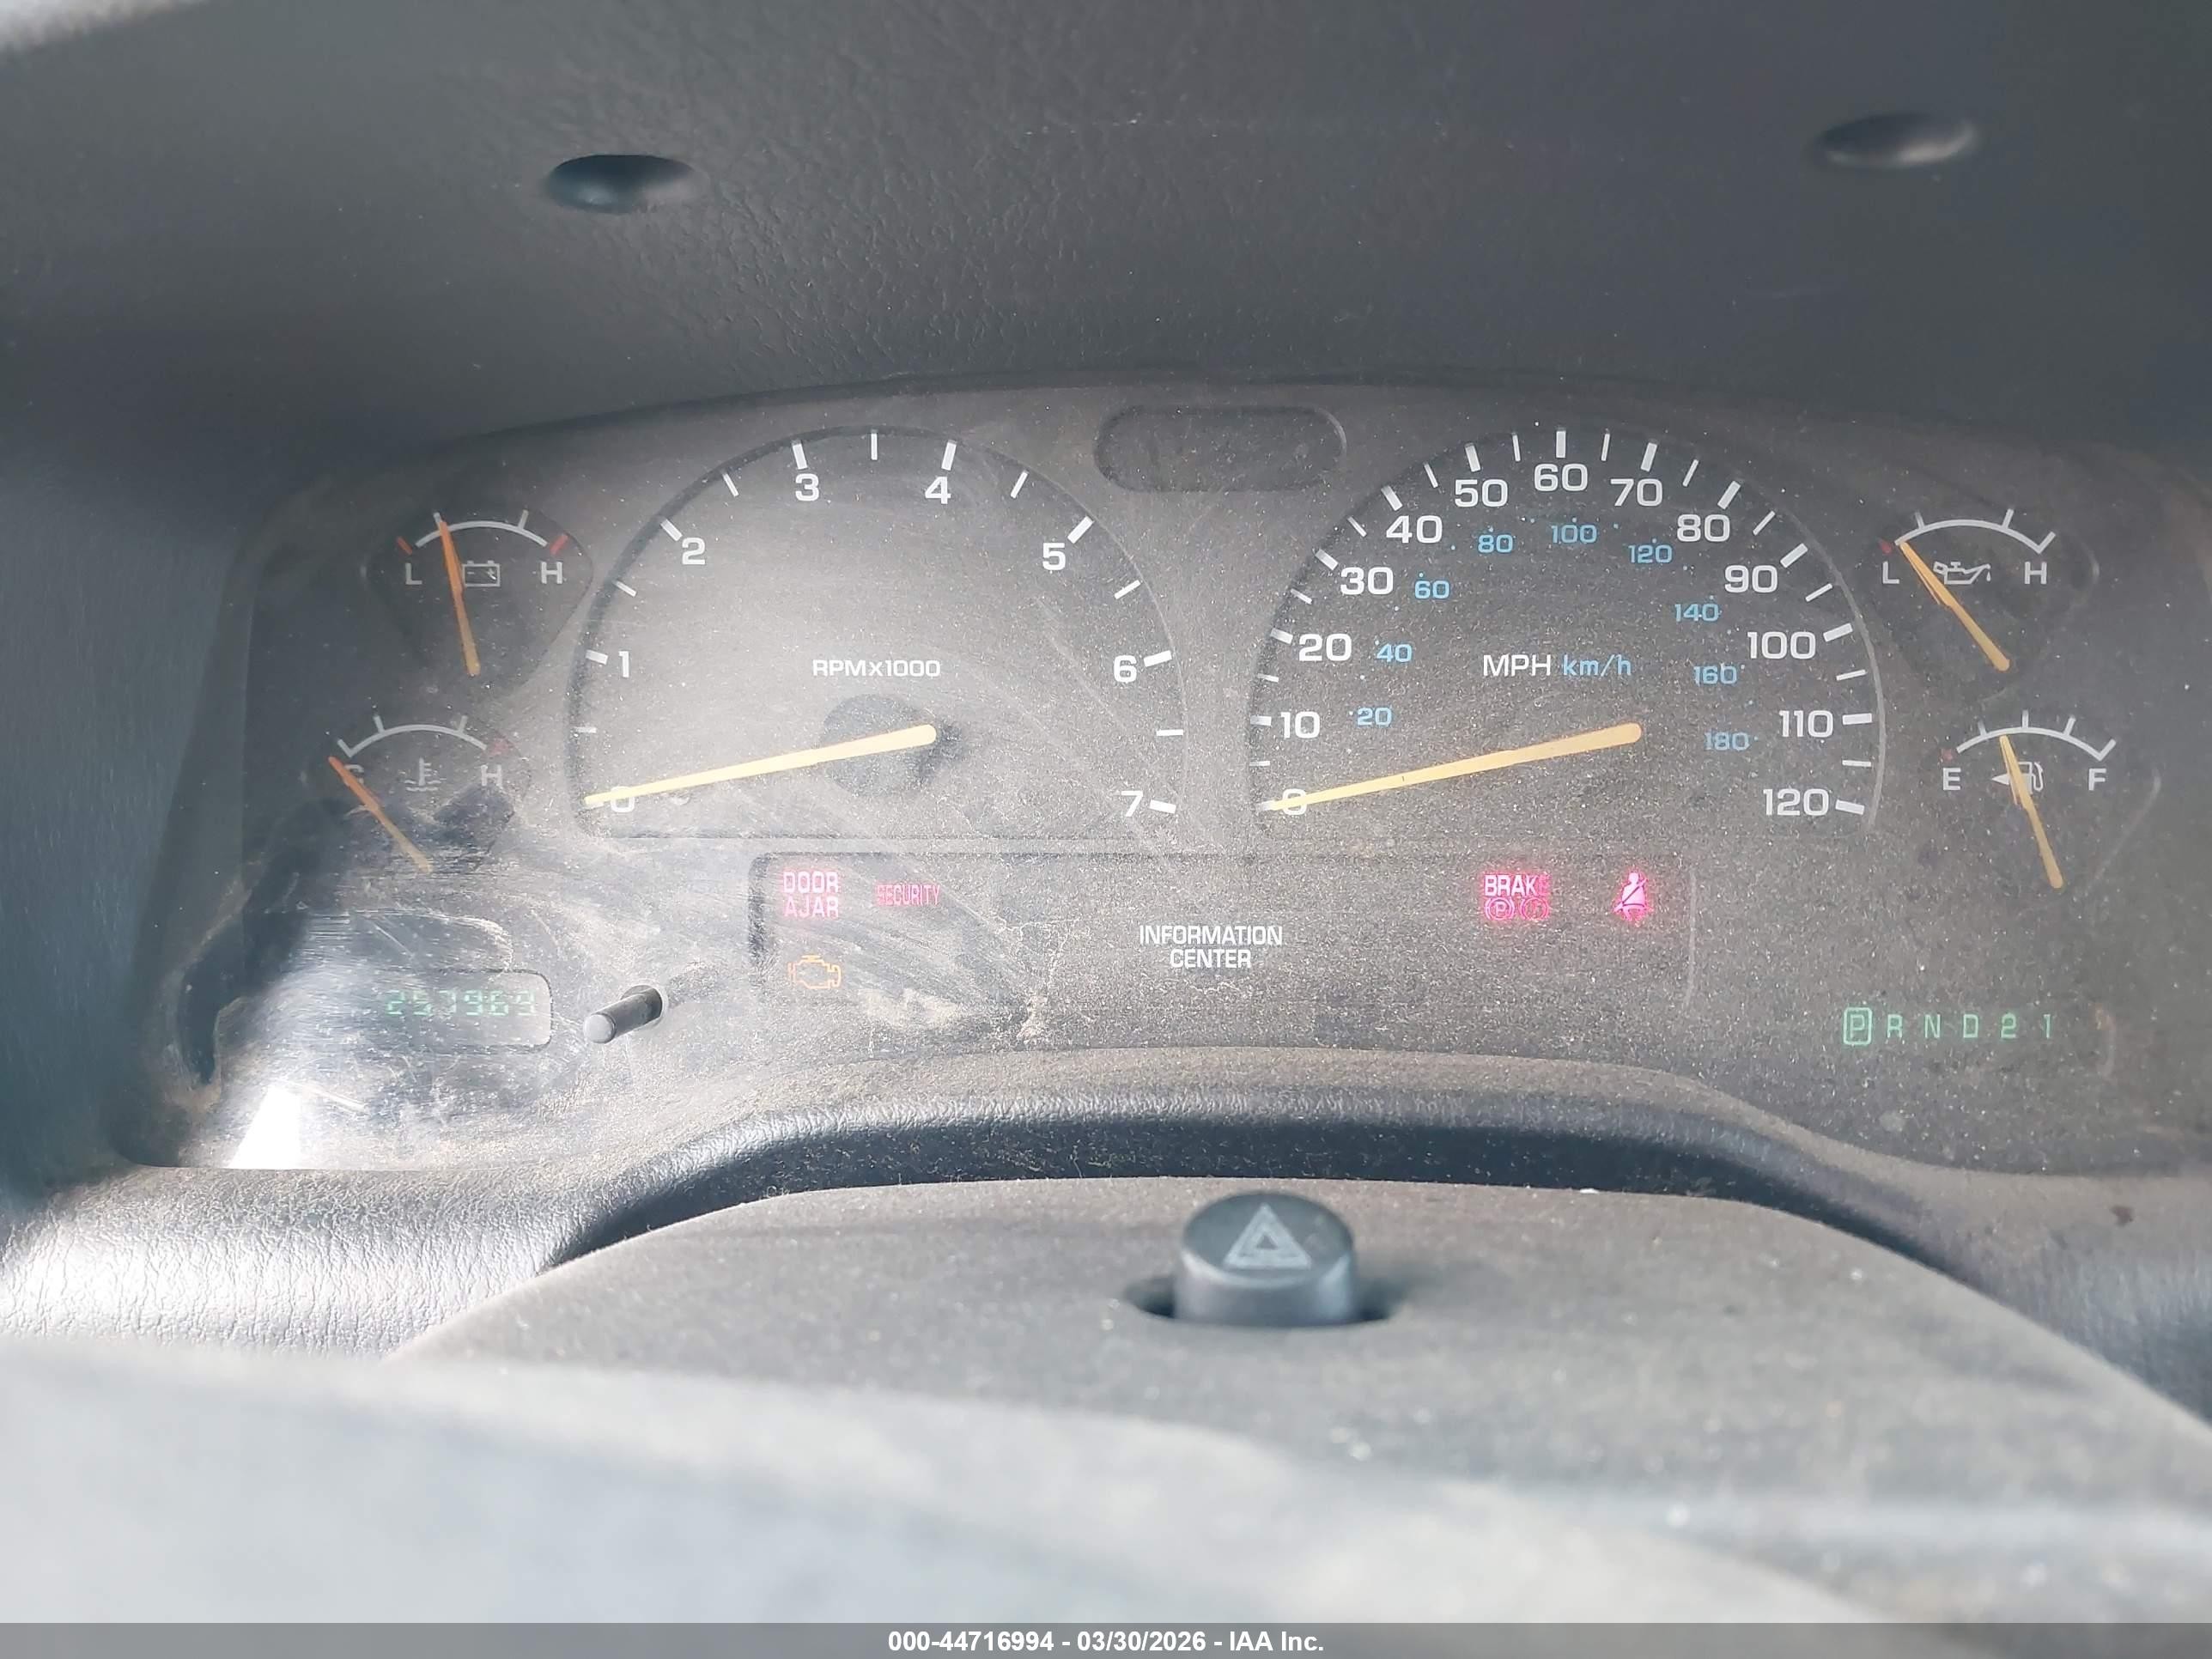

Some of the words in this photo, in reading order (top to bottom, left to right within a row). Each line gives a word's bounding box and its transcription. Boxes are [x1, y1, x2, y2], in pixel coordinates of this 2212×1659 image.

[795, 473, 819, 501] 3
[1534, 463, 1589, 492] 60
[925, 477, 951, 504] 4
[1454, 479, 1509, 507] 50
[1610, 478, 1663, 507] 70
[1385, 515, 1443, 544] 40
[1551, 524, 1598, 544] 100
[1676, 514, 1731, 543] 80
[682, 537, 706, 565] 2
[1478, 534, 1513, 554] 80
[1628, 544, 1673, 564] 120
[1042, 542, 1066, 571] 5
[405, 562, 422, 585] L
[540, 561, 563, 585] H
[1340, 567, 1394, 595] 30
[1724, 564, 1778, 593] 90
[1882, 561, 1899, 584] L
[2024, 561, 2047, 585] H
[1414, 580, 1450, 599] 60
[1674, 603, 1720, 623] 140
[1298, 633, 1352, 661] 20
[1376, 643, 1413, 663] 40
[1747, 630, 1817, 660] 100
[618, 651, 629, 678] 1
[812, 659, 941, 678] RPMx1000
[1114, 655, 1138, 683] 6
[1483, 654, 1552, 677] MPH
[1563, 653, 1632, 677] km/h
[1693, 665, 1738, 685] 160
[1279, 710, 1321, 738] 10
[1356, 707, 1393, 728] 20
[1778, 709, 1834, 738] 110
[1705, 732, 1750, 751] 180
[481, 764, 503, 787] H
[1942, 767, 1960, 791] E
[2089, 767, 2106, 791] F
[1120, 790, 1144, 817] 7
[1281, 788, 1308, 816] 0
[1763, 787, 1830, 817] 120
[782, 871, 839, 894] DOOR
[783, 896, 839, 918] AJAR
[876, 884, 940, 906] SECURITY
[1139, 925, 1283, 945] INFORMATION
[1170, 948, 1252, 969] CENTER
